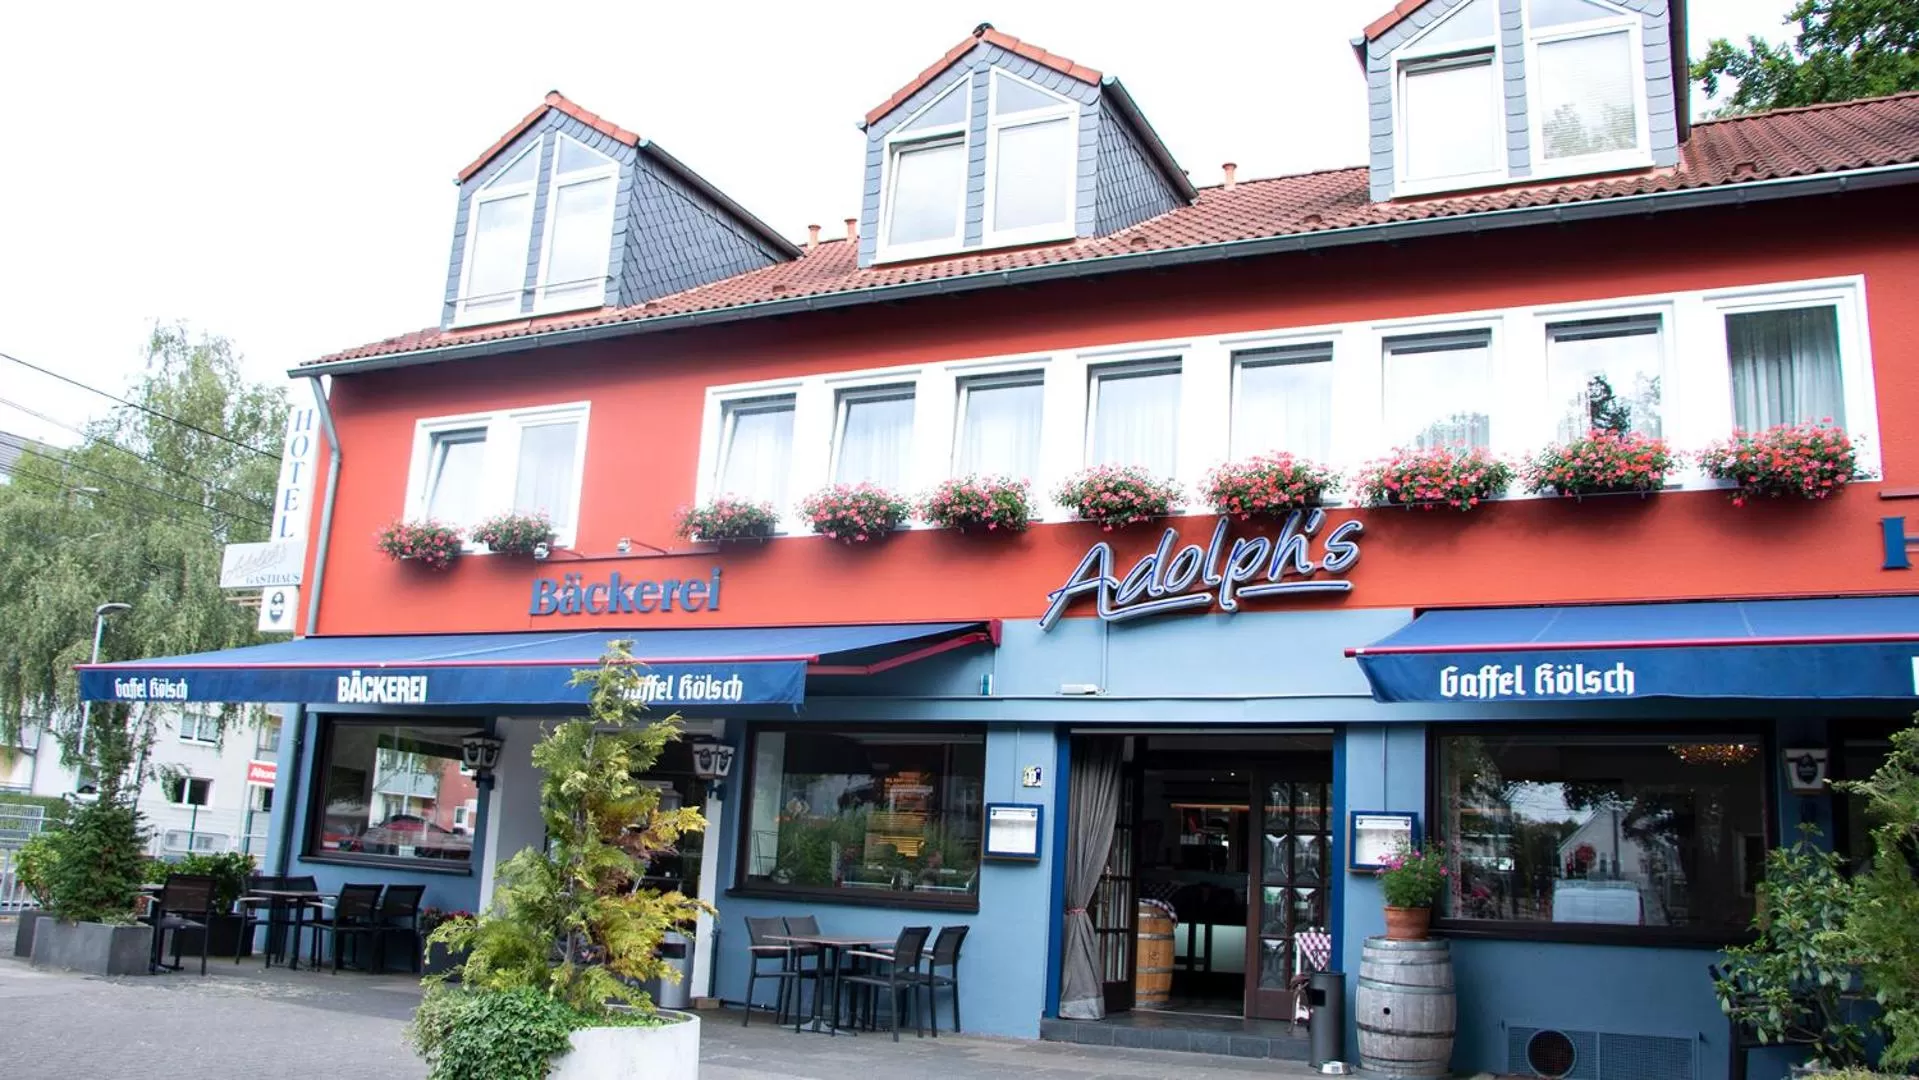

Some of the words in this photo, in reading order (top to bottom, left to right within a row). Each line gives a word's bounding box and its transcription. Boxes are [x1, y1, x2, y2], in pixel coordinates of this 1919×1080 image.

[280, 409, 313, 537] HOTEL
[245, 573, 300, 584] GASTHAUS
[1038, 508, 1364, 632] Adolph's
[529, 566, 722, 616] Bäckerei
[115, 678, 147, 699] Gaffel
[149, 678, 188, 700] Kölsch
[337, 670, 427, 703] BÄCKEREI
[678, 674, 743, 702] Kölsch
[1440, 664, 1526, 699] Gaffel
[1535, 662, 1635, 696] Kölsch
